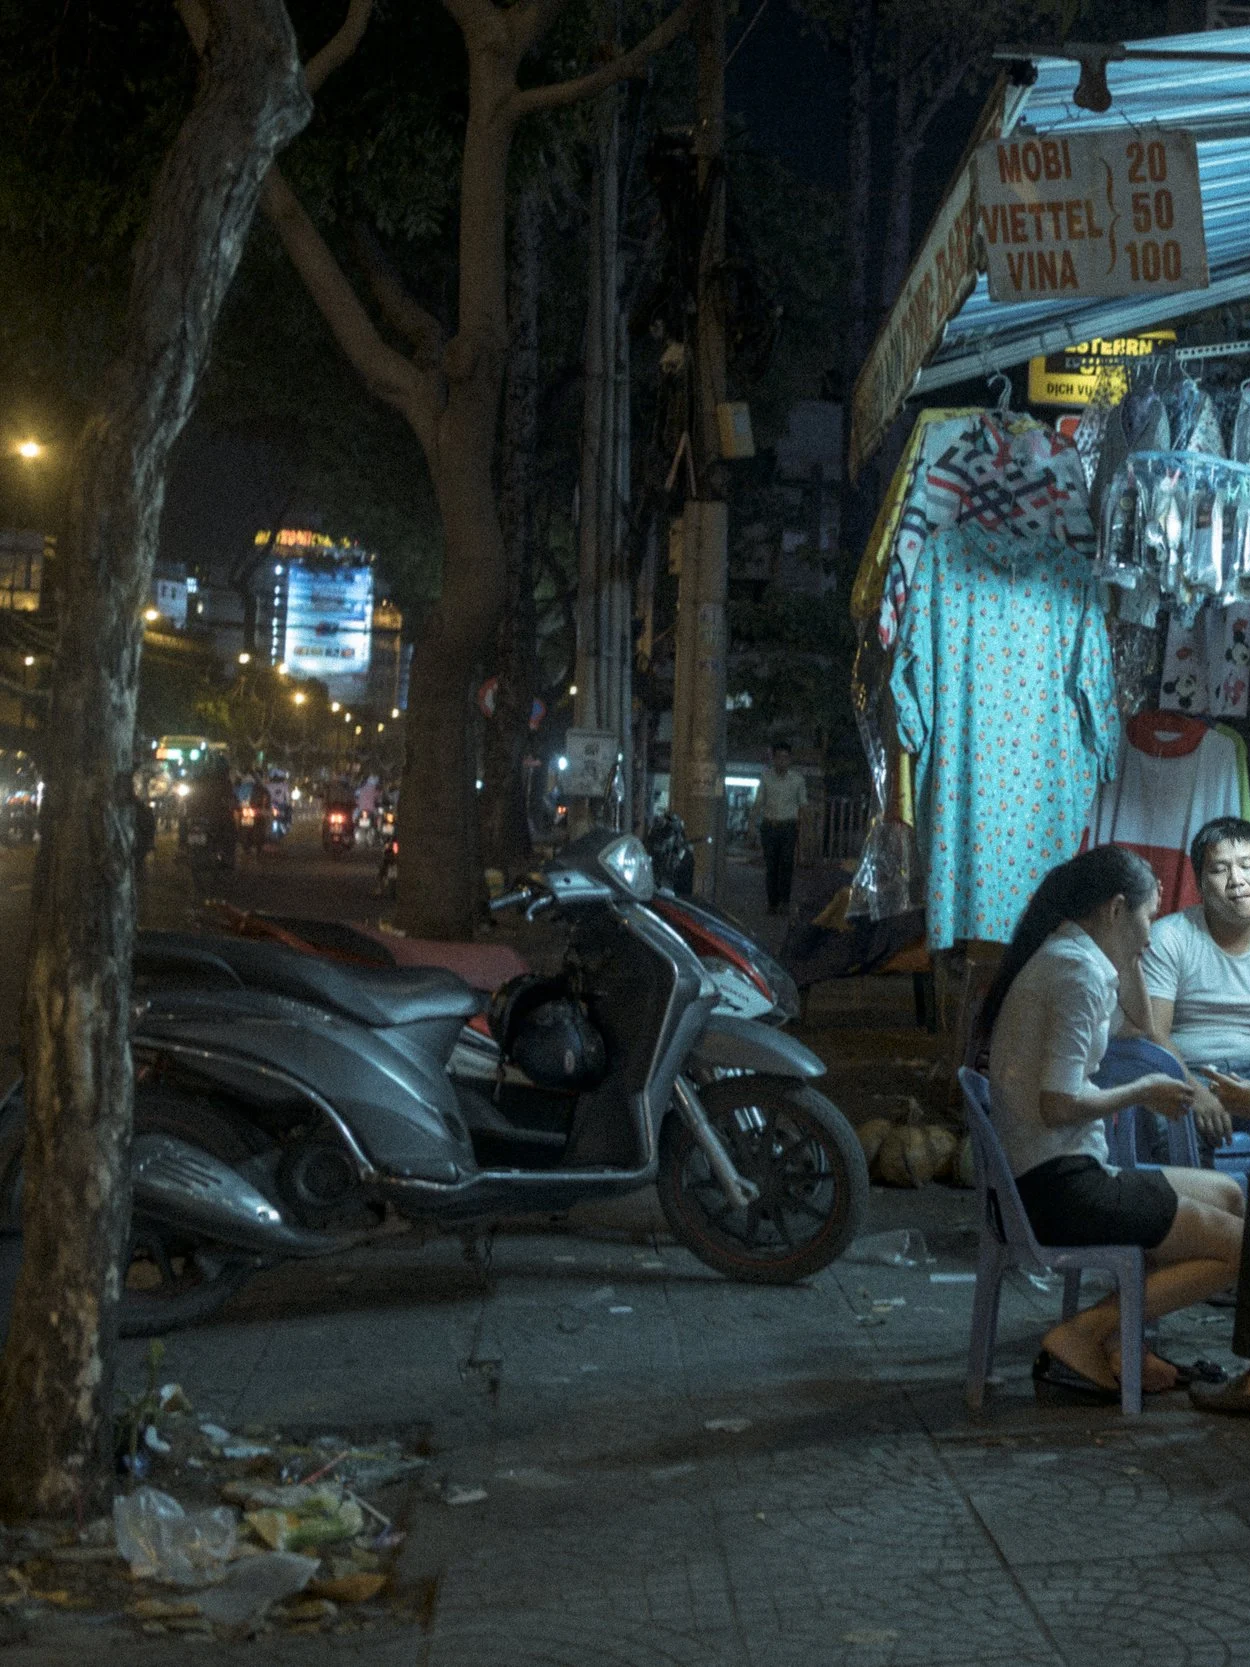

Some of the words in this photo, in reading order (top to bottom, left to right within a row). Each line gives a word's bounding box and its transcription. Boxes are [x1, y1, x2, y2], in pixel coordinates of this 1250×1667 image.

[999, 138, 1073, 185] MOBI
[1126, 141, 1168, 185] 20
[980, 198, 1104, 245] VIETTEL
[1131, 188, 1175, 234] 50
[1006, 251, 1080, 293] VINA
[1124, 239, 1182, 283] 100
